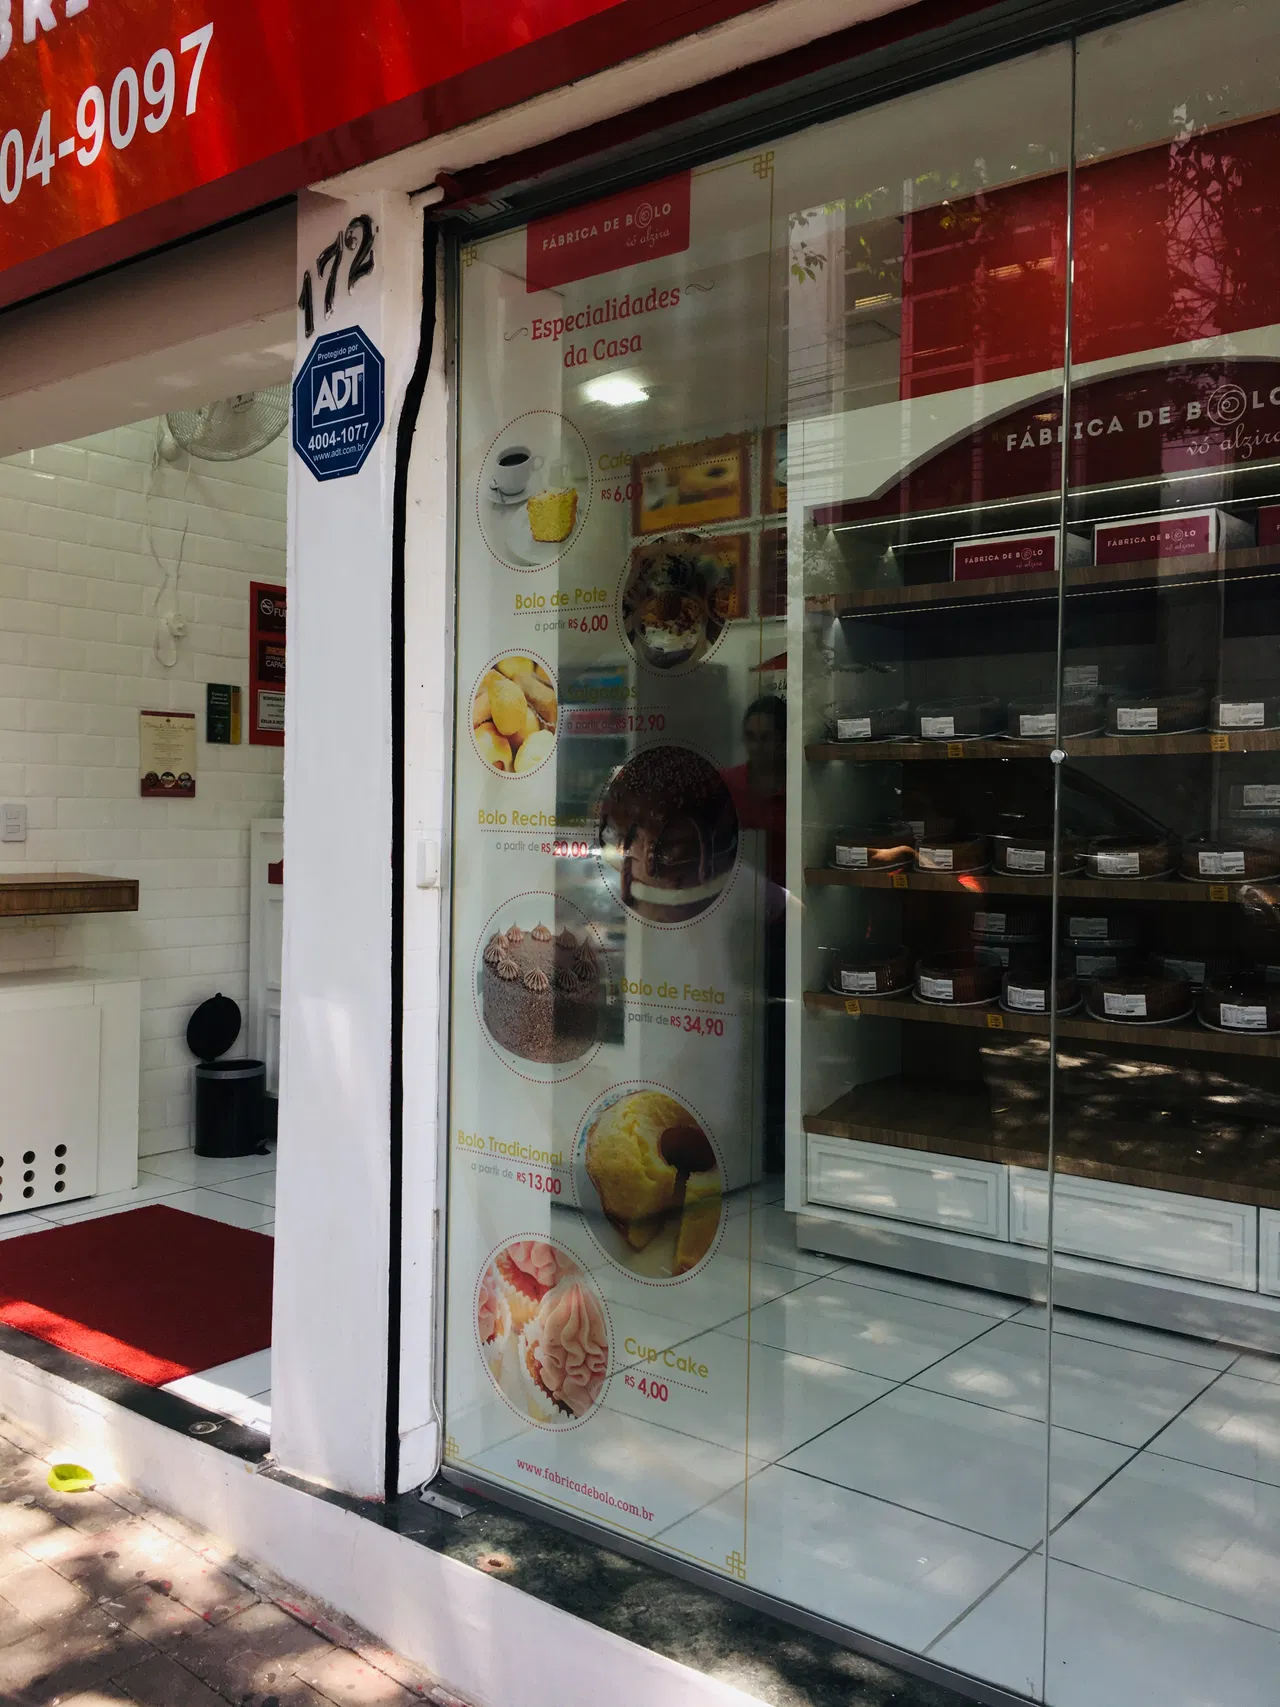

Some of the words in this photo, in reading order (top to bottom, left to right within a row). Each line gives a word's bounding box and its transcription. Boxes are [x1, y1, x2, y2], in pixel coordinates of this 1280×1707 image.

[542, 225, 599, 251] FÁBRICA
[603, 218, 620, 233] DE
[298, 214, 377, 338] 172
[531, 287, 680, 341] Especialidades
[317, 347, 347, 361] Protegido
[346, 343, 359, 355] por
[563, 345, 588, 368] da
[593, 334, 643, 361] Casa
[313, 364, 364, 416] ADT
[1137, 406, 1171, 429] DE
[307, 422, 369, 451] 4004-1077
[312, 443, 365, 462] www.adt.com.br
[598, 448, 633, 471] Café
[601, 488, 611, 500] R$
[613, 481, 643, 504] 6,00
[1106, 536, 1147, 548] FÁBRICA
[1149, 533, 1161, 542] DE
[964, 552, 1000, 564] FÁBRICA
[1002, 552, 1013, 560] DE
[515, 592, 546, 610] Bolo
[550, 591, 569, 607] de
[575, 587, 608, 604] Pote
[534, 623, 541, 632] a
[542, 619, 567, 633] partir
[568, 619, 578, 630] R$
[580, 614, 608, 634] 6,00
[615, 717, 627, 729] R$
[627, 713, 665, 733] 12,90
[478, 809, 507, 825] Bolo
[496, 842, 501, 850] a
[504, 841, 526, 853] partir
[528, 841, 540, 852] de
[541, 843, 551, 854] R$
[552, 840, 588, 858] 20,00
[620, 976, 652, 997] Bolo
[657, 981, 678, 999] de
[683, 983, 725, 1005] Festa
[628, 1012, 653, 1025] partir
[656, 1014, 669, 1026] de
[670, 1015, 681, 1028] R$
[683, 1015, 724, 1036] 34,90
[458, 1130, 485, 1150] Bolo
[488, 1136, 563, 1166] Tradicional
[471, 1162, 477, 1170] a
[478, 1162, 501, 1177] partir
[503, 1166, 513, 1179] de
[516, 1172, 526, 1184] R$
[528, 1172, 562, 1195] 13,00
[624, 1337, 657, 1364] Cup
[663, 1350, 709, 1378] Cake
[624, 1375, 635, 1388] R$
[637, 1377, 668, 1402] 4,00
[516, 1458, 655, 1522] www.fabricadebolo.com.br
